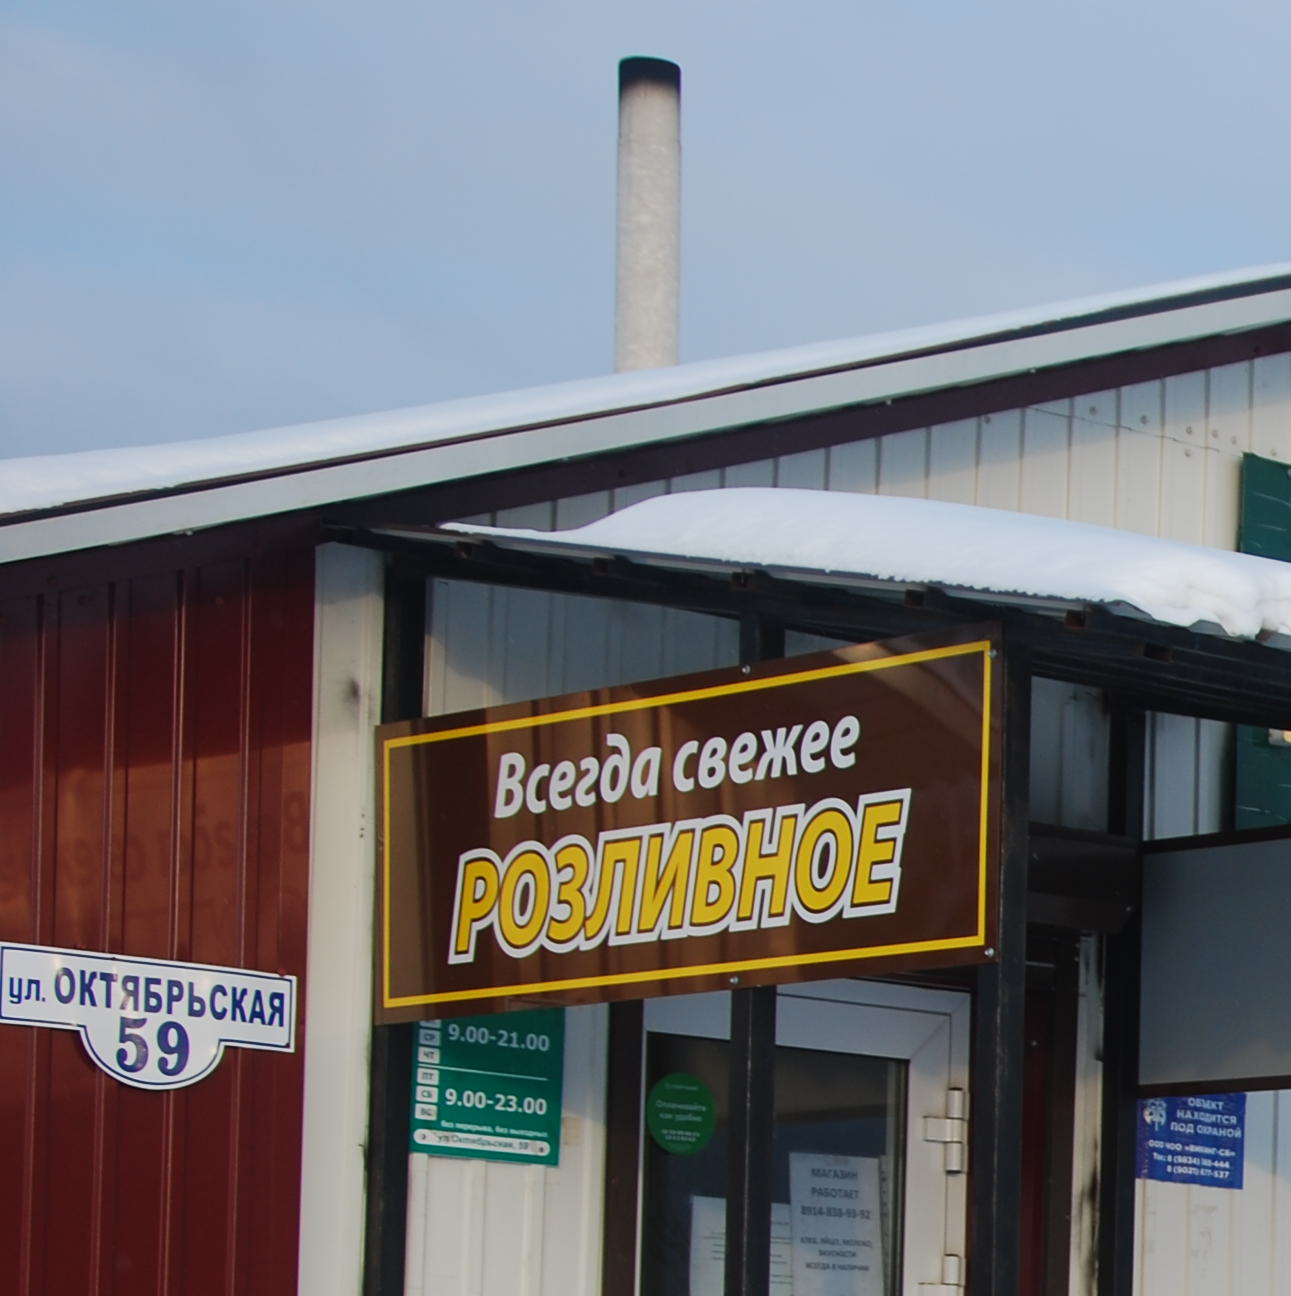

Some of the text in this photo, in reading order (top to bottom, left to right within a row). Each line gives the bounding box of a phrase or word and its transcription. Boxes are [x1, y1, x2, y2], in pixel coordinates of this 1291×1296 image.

[494, 715, 861, 818] Всегда свежее
[447, 788, 912, 965] РОЗЛИВНОЕ
[9, 967, 286, 1028] ул. ОКТЯБРЬСКАЯ
[116, 1016, 190, 1077] 59
[448, 1024, 550, 1051] 9.00-21.00
[445, 1088, 547, 1116] 9.00-23.00
[1169, 1121, 1195, 1135] ПОД
